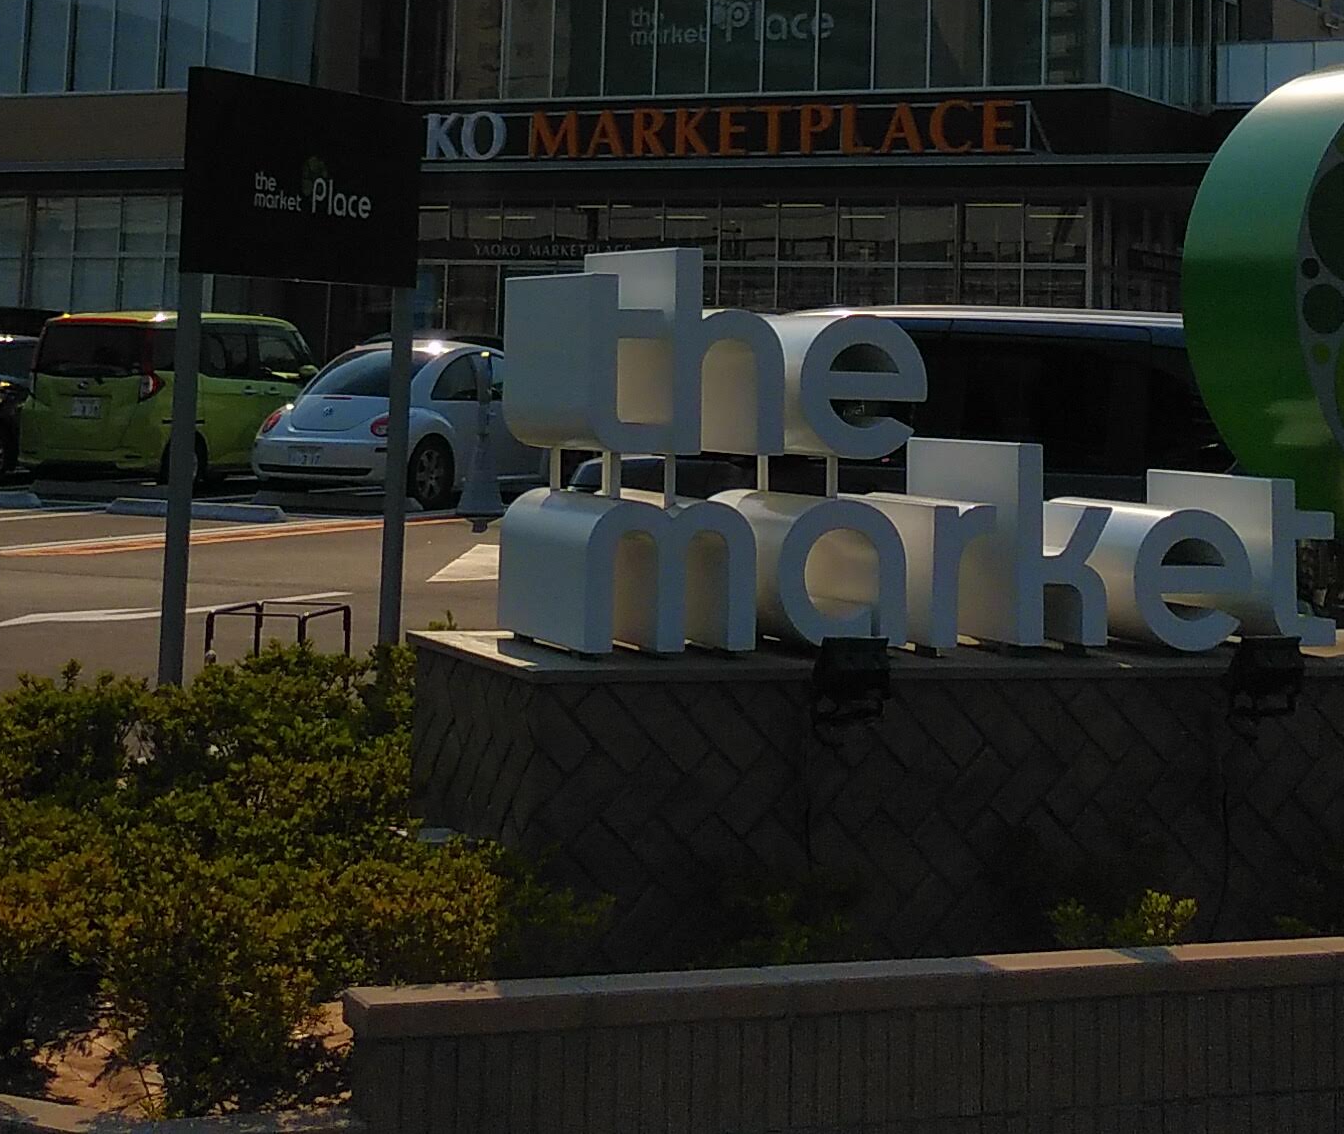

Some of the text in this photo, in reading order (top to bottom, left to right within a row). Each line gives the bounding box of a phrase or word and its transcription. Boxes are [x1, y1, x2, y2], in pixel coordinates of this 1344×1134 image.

[630, 23, 709, 46] market
[528, 98, 1017, 159] MARKETPLACE
[254, 170, 278, 192] the
[253, 189, 303, 213] market
[473, 243, 521, 257] YAOKO
[536, 248, 928, 459] the
[542, 441, 1338, 654] market
